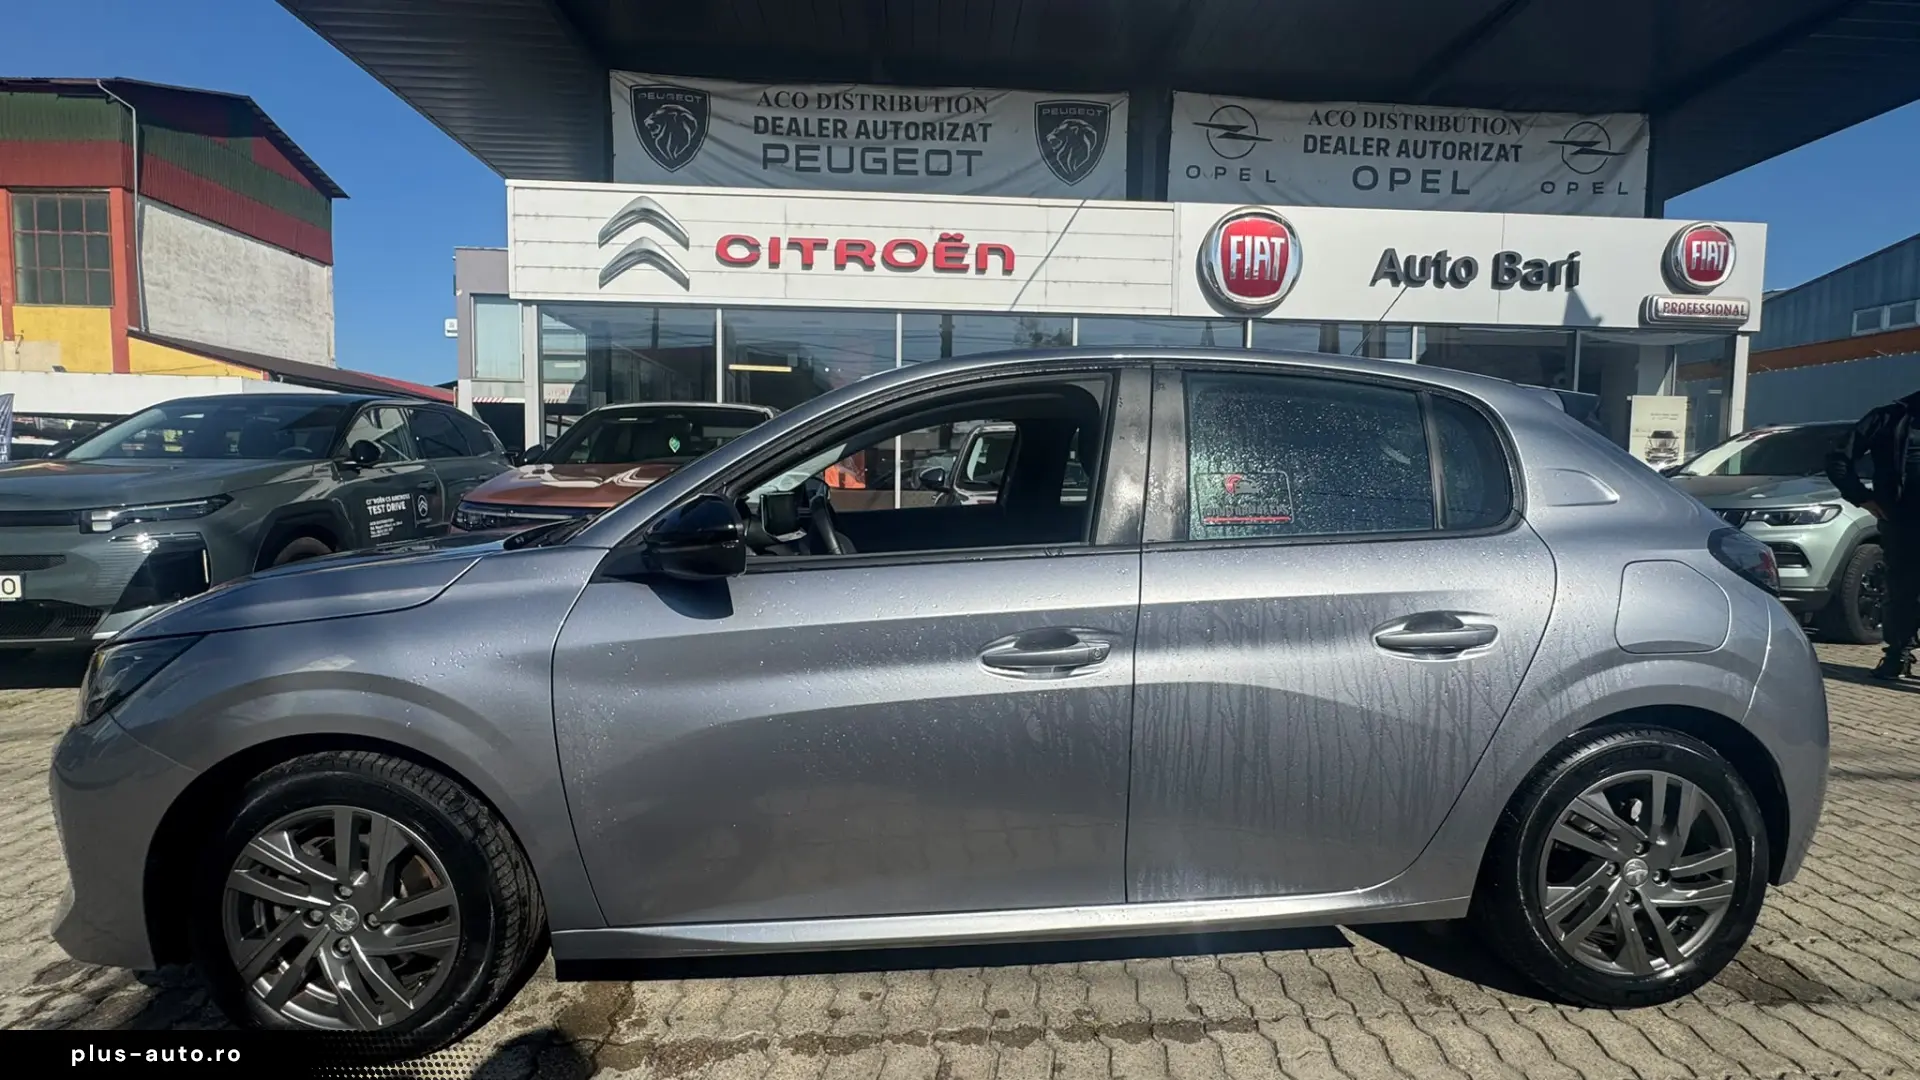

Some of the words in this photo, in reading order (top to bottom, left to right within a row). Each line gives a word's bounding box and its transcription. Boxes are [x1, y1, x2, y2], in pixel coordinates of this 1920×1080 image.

[638, 91, 702, 103] PEUGEOT
[756, 90, 809, 110] ACO
[816, 92, 989, 115] DISTRIBUTION
[1042, 107, 1103, 117] PEUGEOT
[1307, 109, 1356, 128] ACO
[1363, 111, 1524, 136] DISTRIBUTION
[753, 115, 848, 140] DEALER
[855, 119, 993, 143] AUTORIZAT
[762, 142, 983, 177] PEUGEOT
[1303, 134, 1390, 158] DEALER
[1396, 139, 1524, 163] AUTORIZAT
[1185, 164, 1277, 184] OPEL
[1352, 165, 1471, 195] OPEL
[1540, 180, 1629, 196] OPEL
[1229, 234, 1286, 282] FIAT
[1369, 247, 1480, 290] Auto
[1690, 239, 1728, 271] FIAT
[1662, 301, 1747, 317] PROFESSIONAL
[367, 504, 386, 515] TEST
[386, 501, 406, 512] DRIVE
